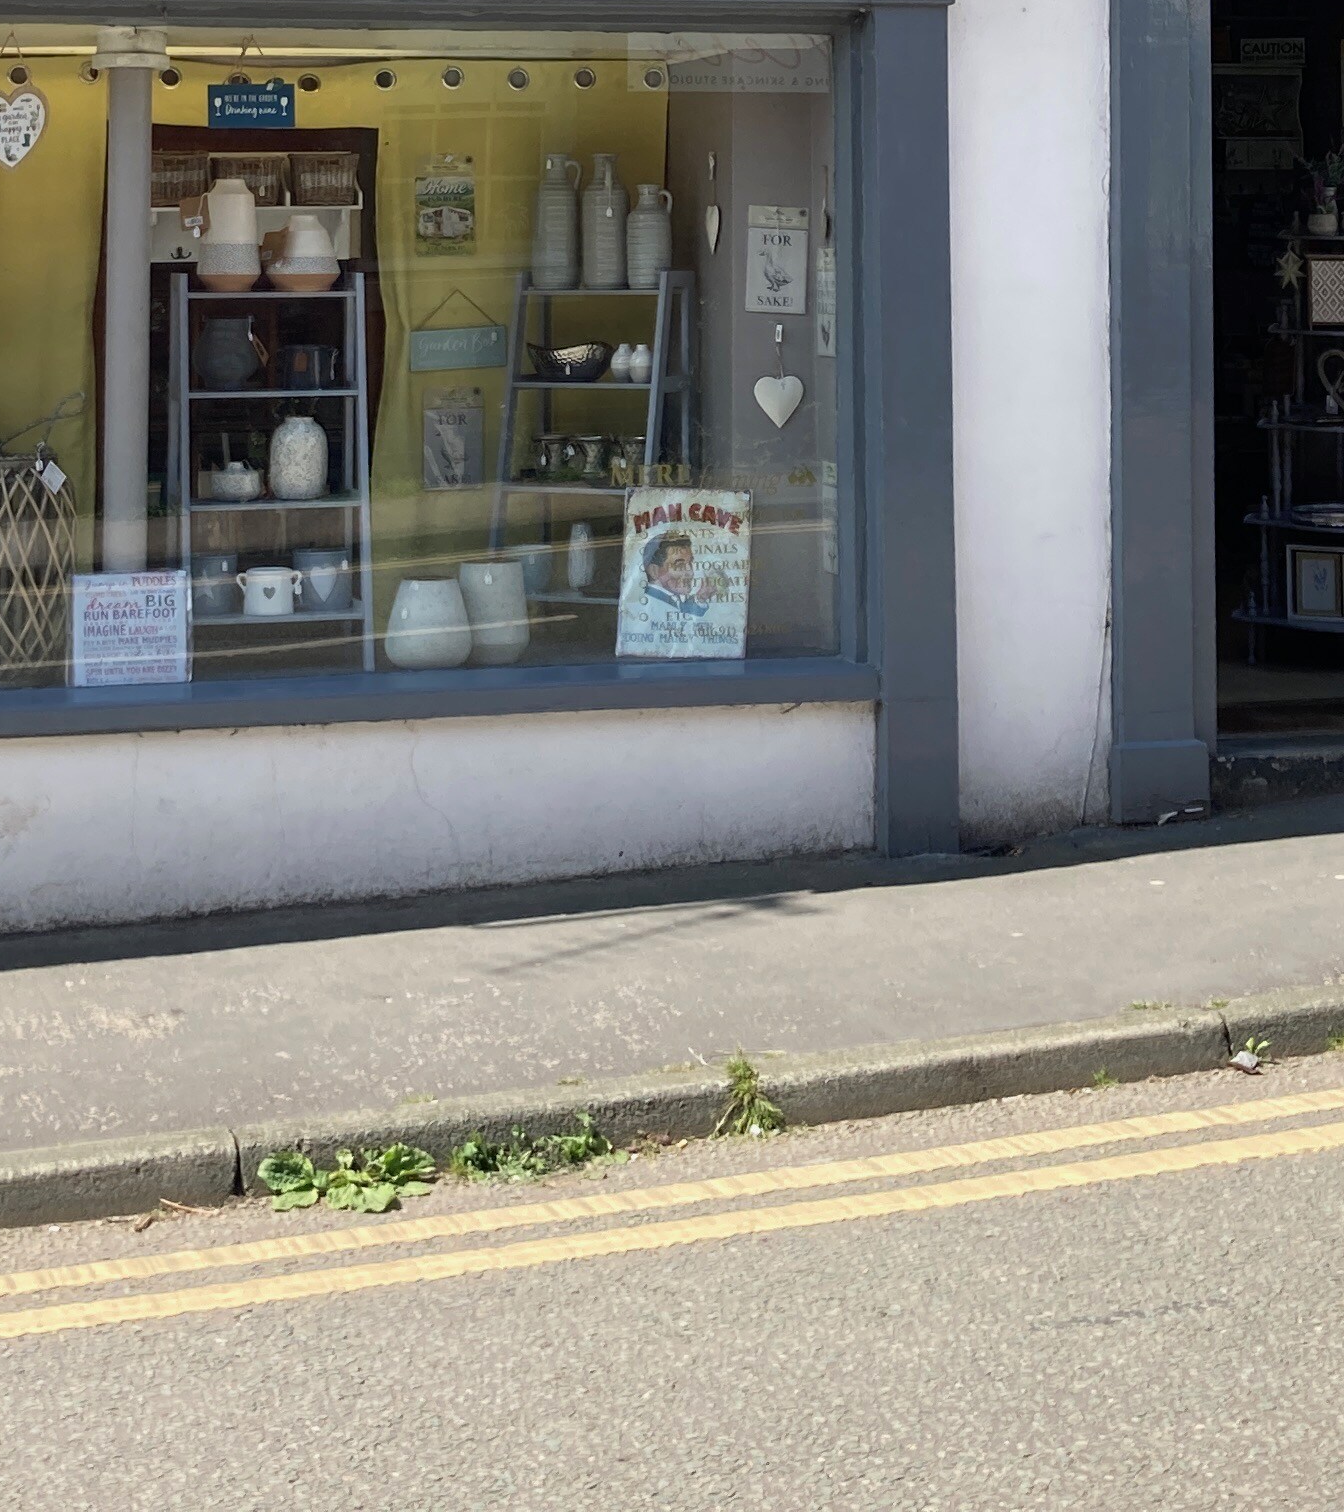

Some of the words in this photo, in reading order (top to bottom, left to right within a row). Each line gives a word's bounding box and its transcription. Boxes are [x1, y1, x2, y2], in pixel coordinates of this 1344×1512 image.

[1242, 42, 1303, 55] CAUTION
[422, 179, 468, 196] Home
[762, 233, 792, 247] FOR
[757, 295, 794, 309] SAKE!
[633, 502, 683, 534] MAN
[688, 502, 744, 537] CAVE
[131, 575, 177, 588] PUDDLES
[86, 597, 139, 611] dream
[145, 594, 175, 608] BIG
[83, 610, 109, 622] RUN
[112, 607, 177, 621] BAREFOOT
[83, 624, 127, 638] IMAGINE
[128, 625, 159, 637] LAUGH
[117, 636, 140, 646] MAKE
